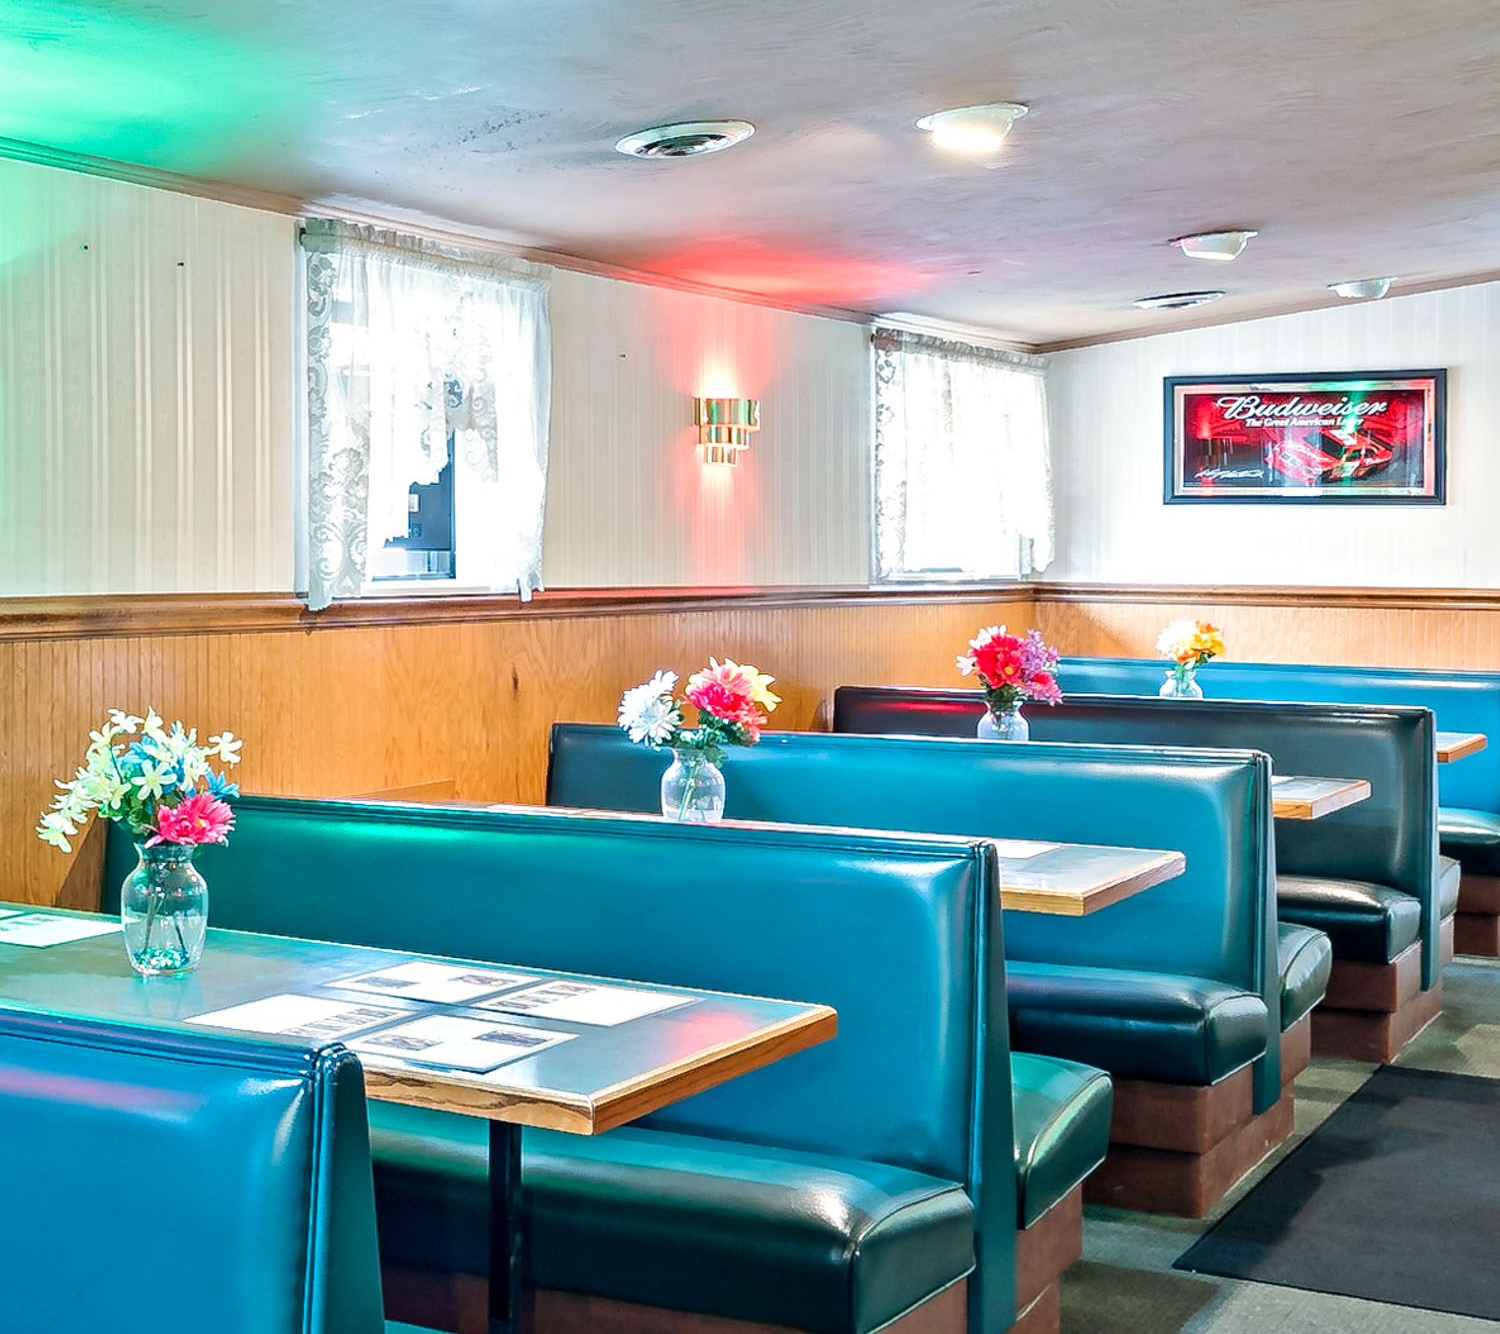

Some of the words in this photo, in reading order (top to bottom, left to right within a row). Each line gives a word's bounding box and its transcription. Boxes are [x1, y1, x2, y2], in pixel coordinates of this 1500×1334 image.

[1216, 395, 1388, 420] Budweiser
[1246, 418, 1263, 427] The
[1264, 418, 1291, 427] Great
[1292, 417, 1335, 427] American
